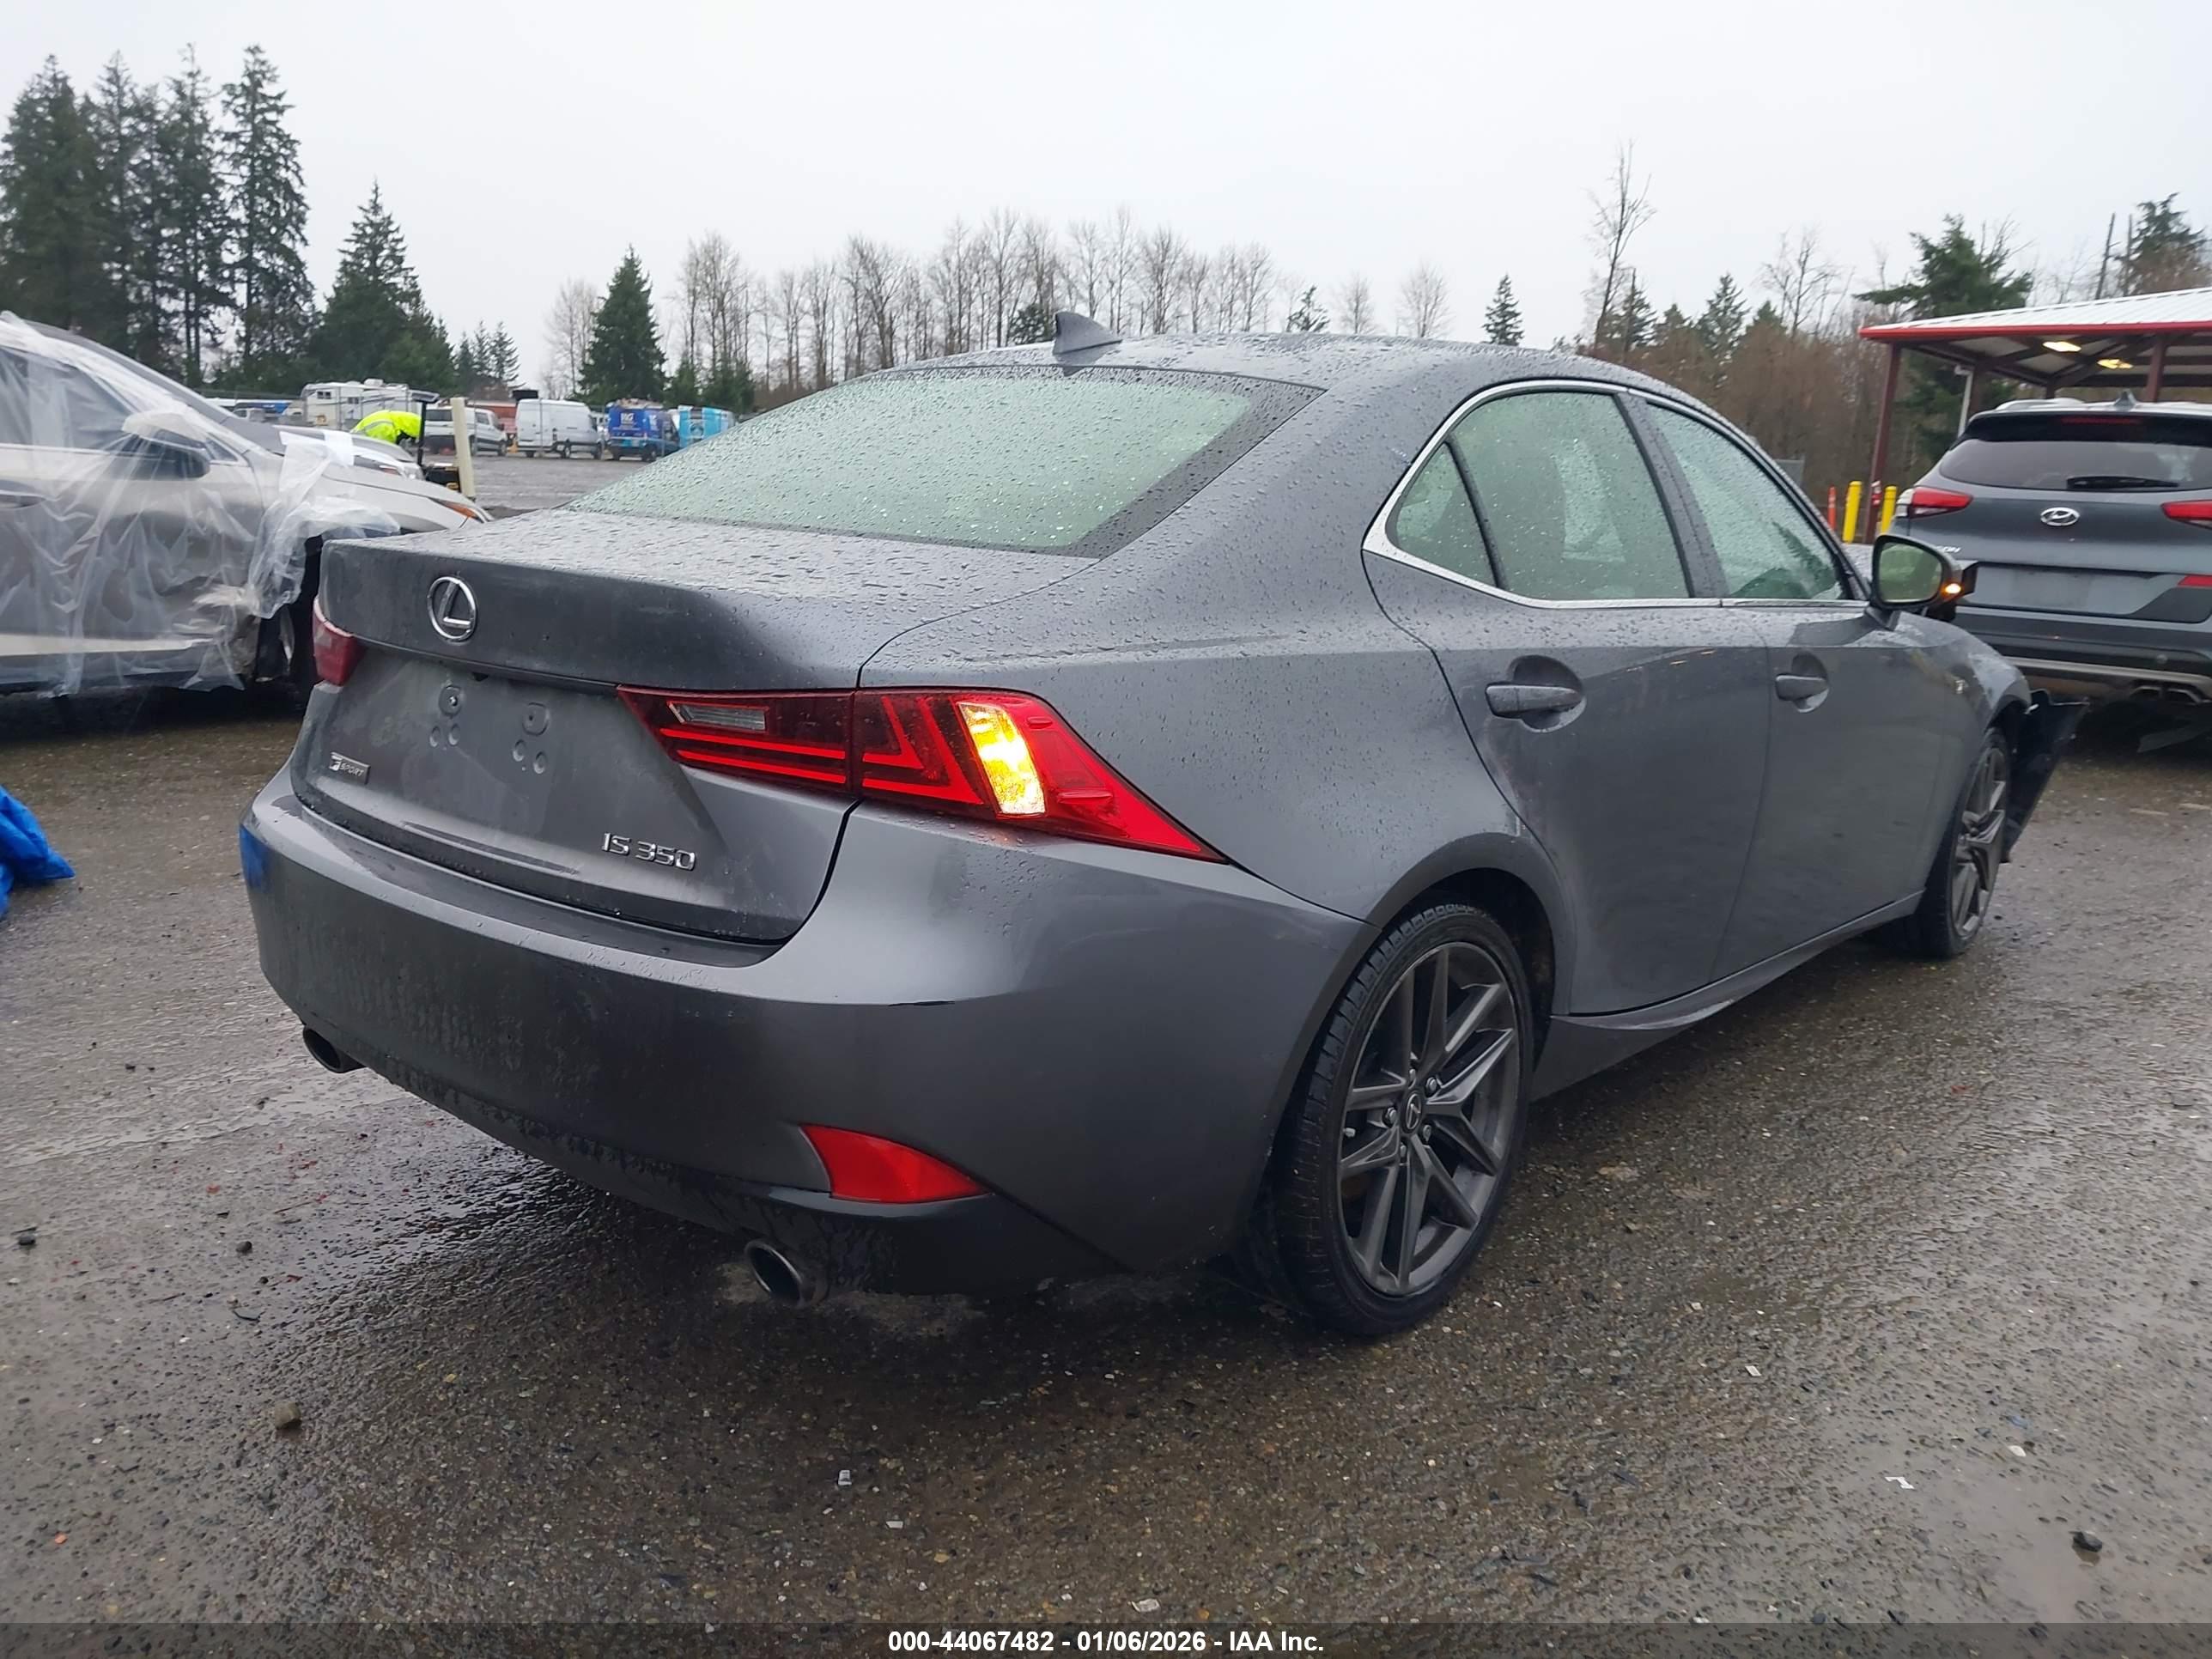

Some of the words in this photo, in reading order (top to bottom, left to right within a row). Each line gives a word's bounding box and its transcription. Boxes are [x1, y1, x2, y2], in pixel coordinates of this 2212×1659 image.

[340, 763, 365, 777] SPORT
[601, 832, 631, 855] IS
[635, 841, 696, 871] 350
